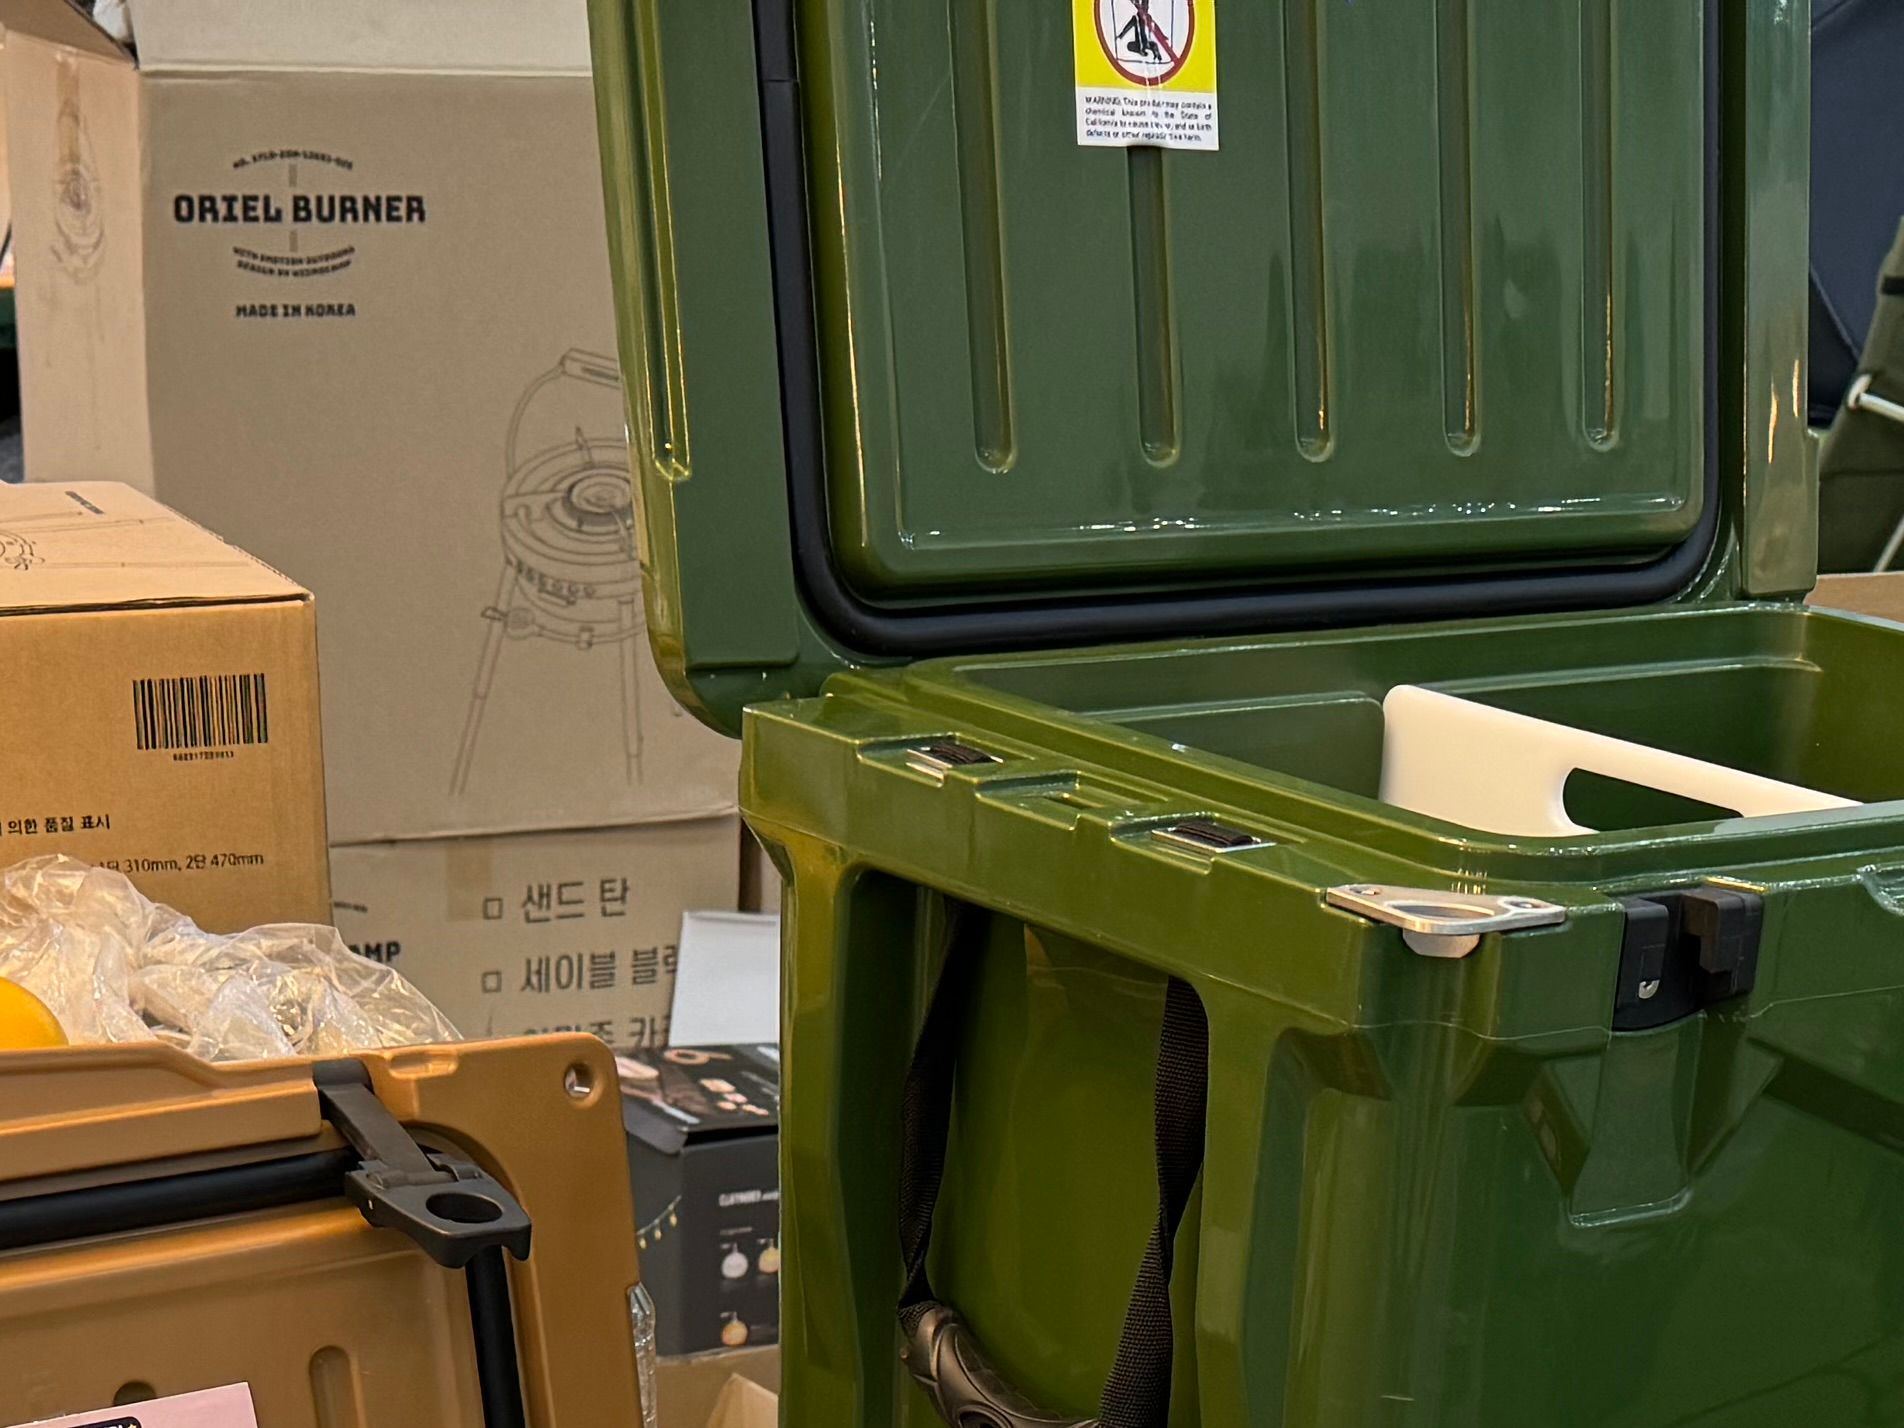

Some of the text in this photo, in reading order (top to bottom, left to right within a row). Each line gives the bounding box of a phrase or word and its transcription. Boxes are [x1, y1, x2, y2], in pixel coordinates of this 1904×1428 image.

[174, 195, 426, 223] ORIEL BURNER
[236, 304, 356, 317] MADE IN KOREA
[7, 819, 39, 837] 의한
[44, 816, 75, 835] 품질
[79, 814, 112, 831] 표시
[210, 851, 265, 868] 470mm
[521, 877, 631, 924] 샌드 탄
[520, 950, 618, 994] 세이블
